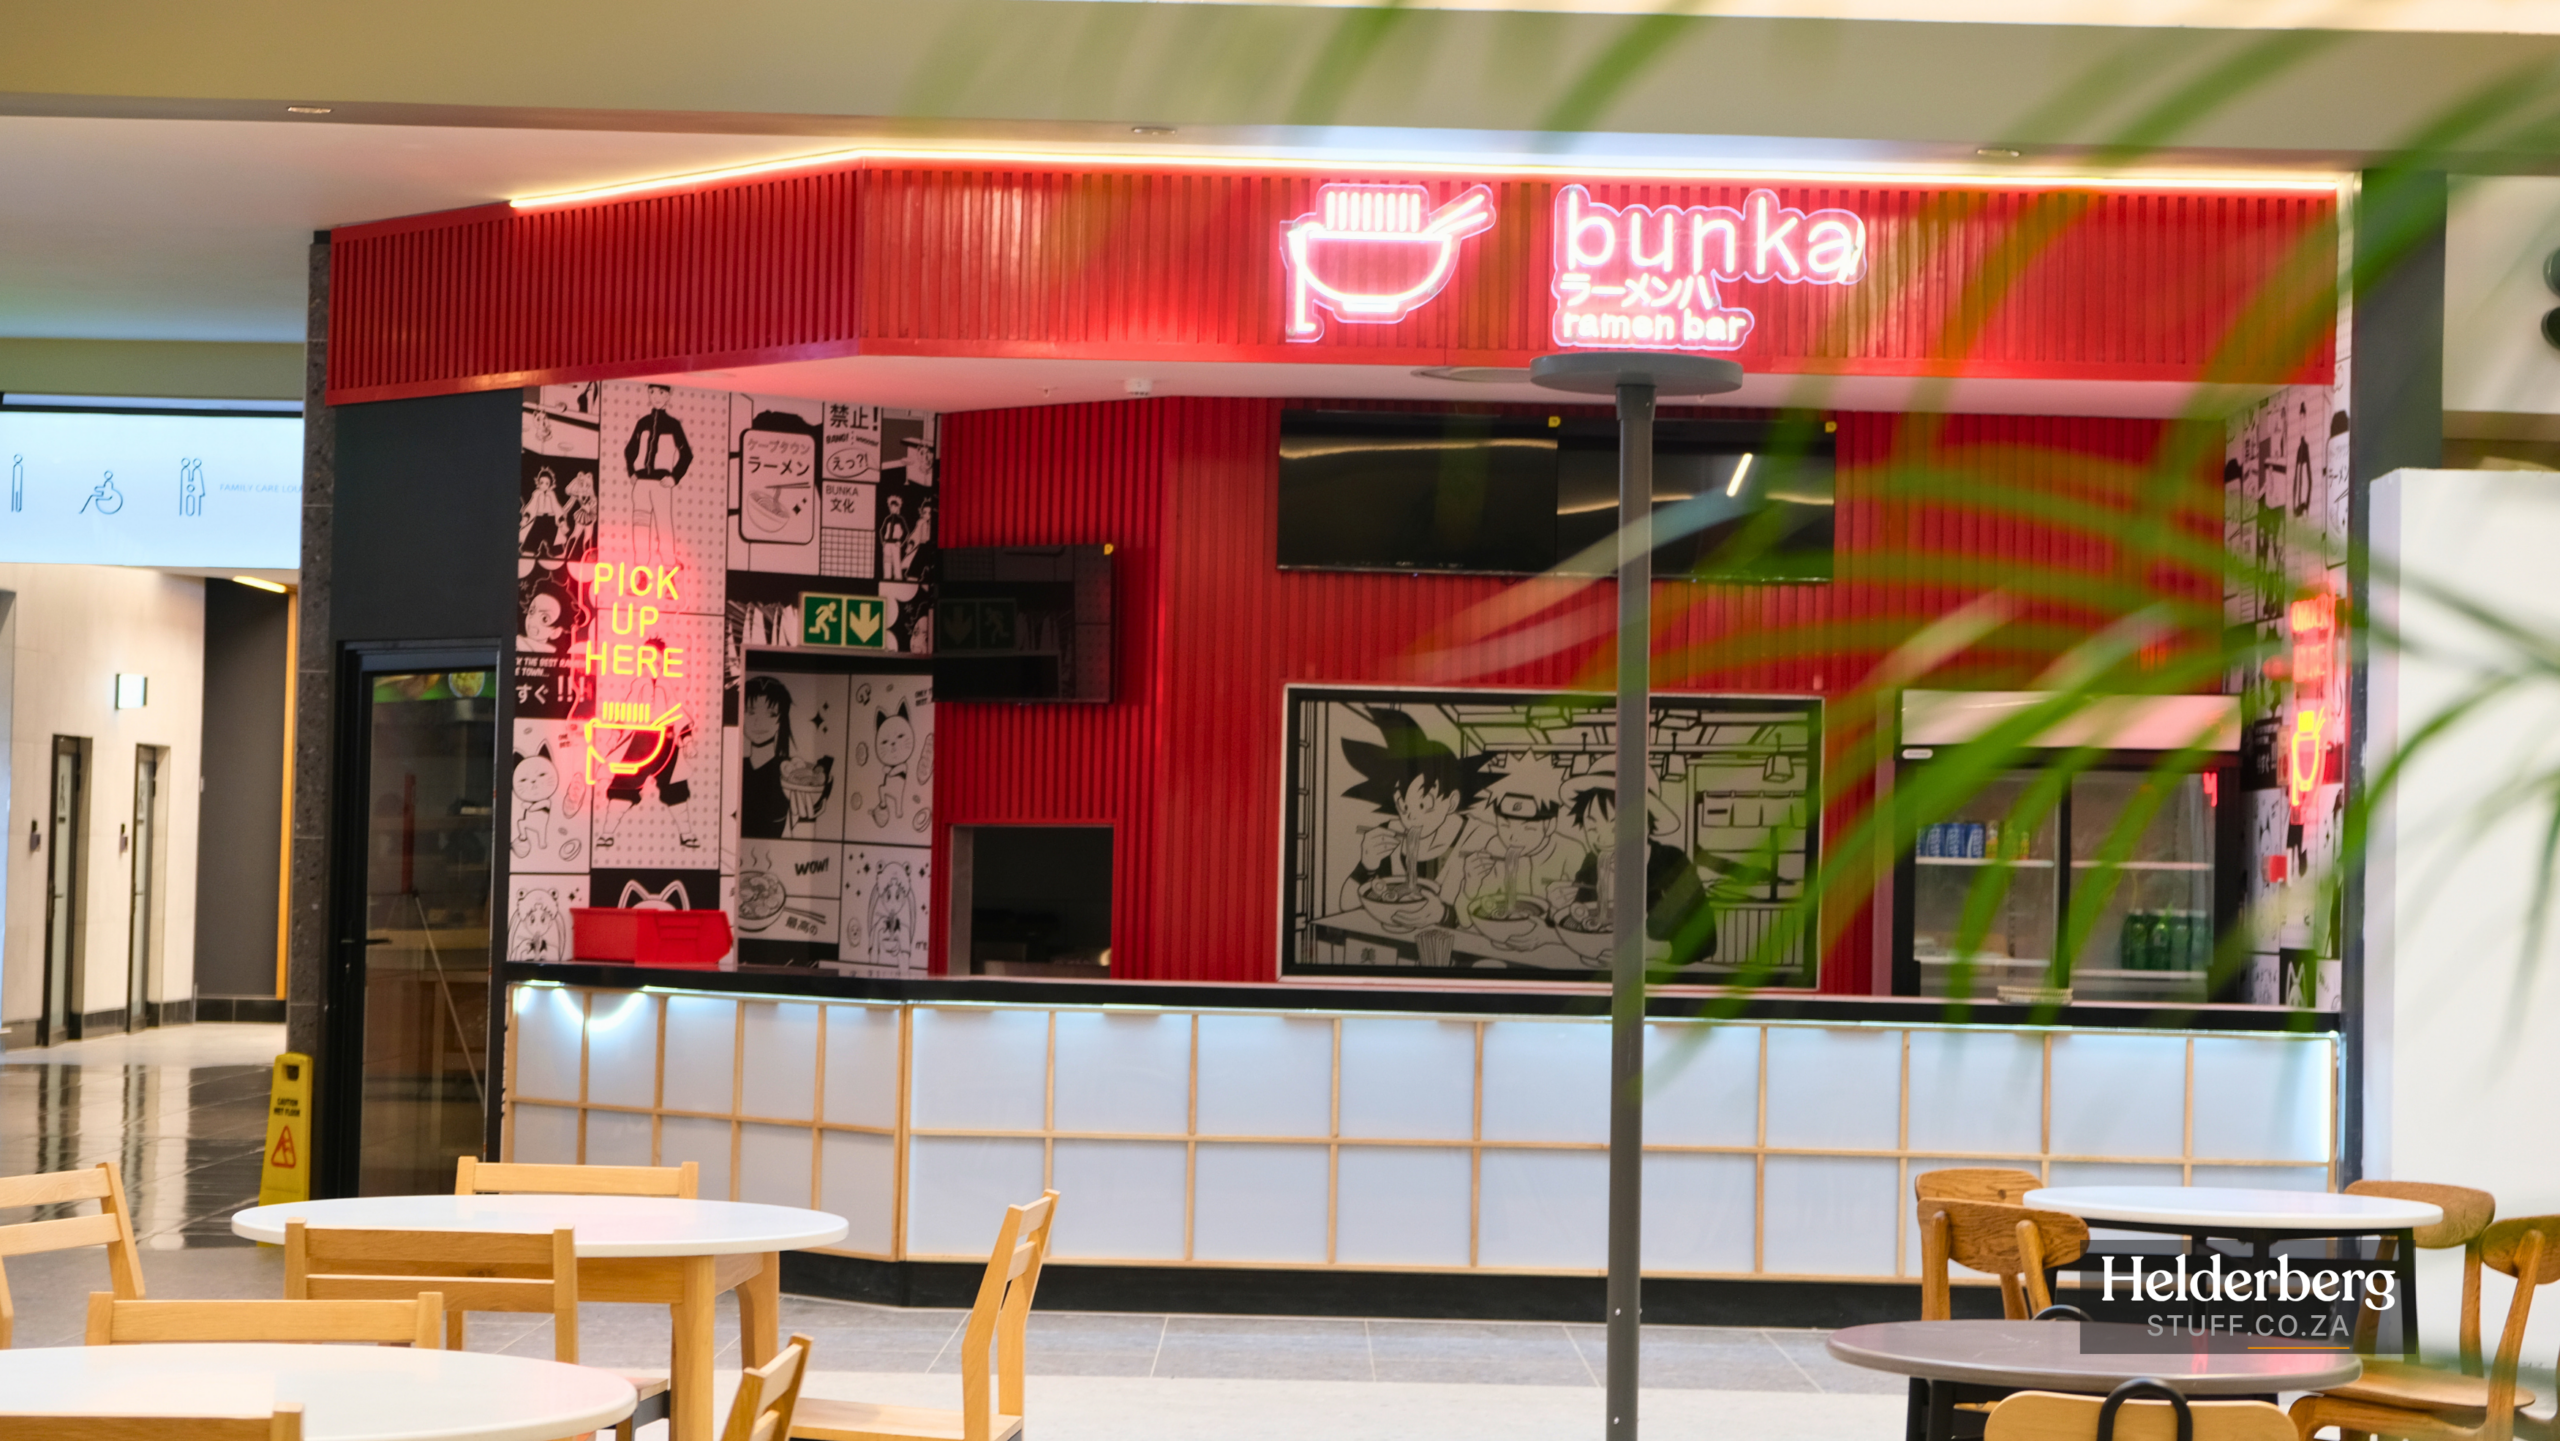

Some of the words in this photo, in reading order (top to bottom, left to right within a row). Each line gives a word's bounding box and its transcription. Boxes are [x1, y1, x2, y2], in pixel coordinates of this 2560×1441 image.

[1567, 190, 1866, 283] bunka
[1562, 312, 1675, 340] ramen
[1682, 307, 1747, 342] bar
[747, 456, 810, 477] ラーメン
[219, 483, 253, 492] FAMILY
[255, 484, 279, 493] CARE
[282, 484, 303, 493] LOU
[826, 485, 859, 496] BUNKA
[830, 498, 855, 513] 文化
[594, 562, 681, 600] PICK
[611, 602, 659, 637] UP
[585, 640, 684, 678] HERE
[794, 857, 830, 876] WOW!
[274, 1107, 283, 1115] WET
[285, 1108, 300, 1116] FLOOR
[277, 1097, 298, 1106] CAUTION
